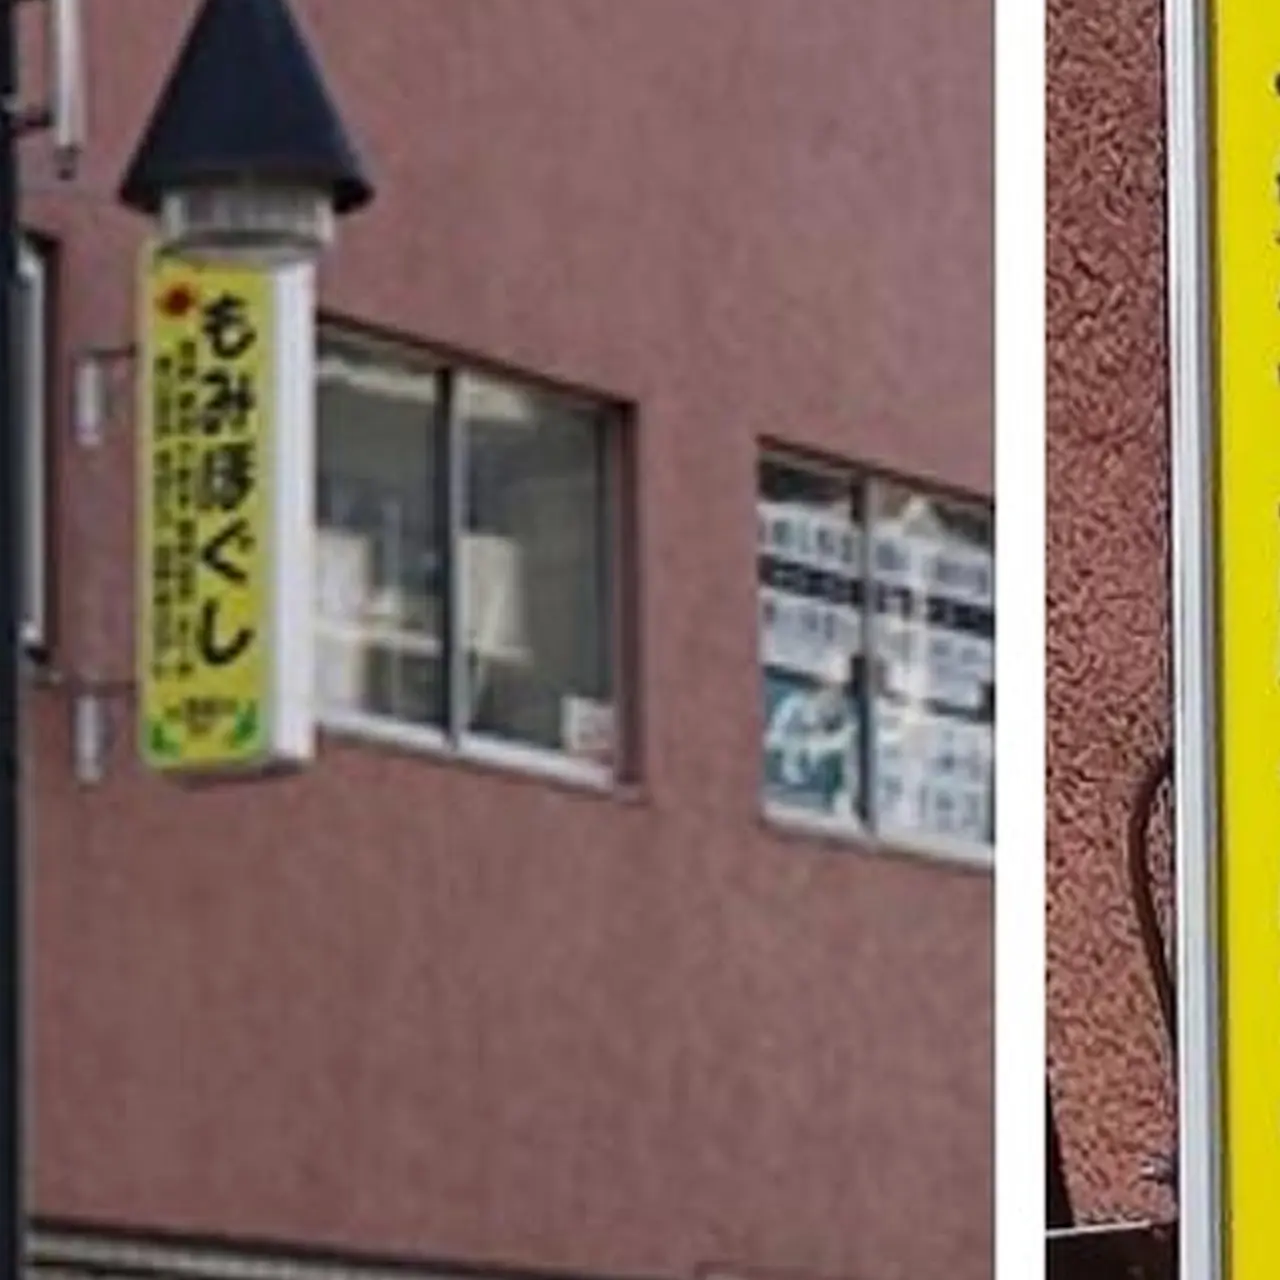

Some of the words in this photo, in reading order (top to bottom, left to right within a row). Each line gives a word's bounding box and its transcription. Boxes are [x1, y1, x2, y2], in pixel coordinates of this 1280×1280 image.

[202, 290, 257, 667] もみほぐし
